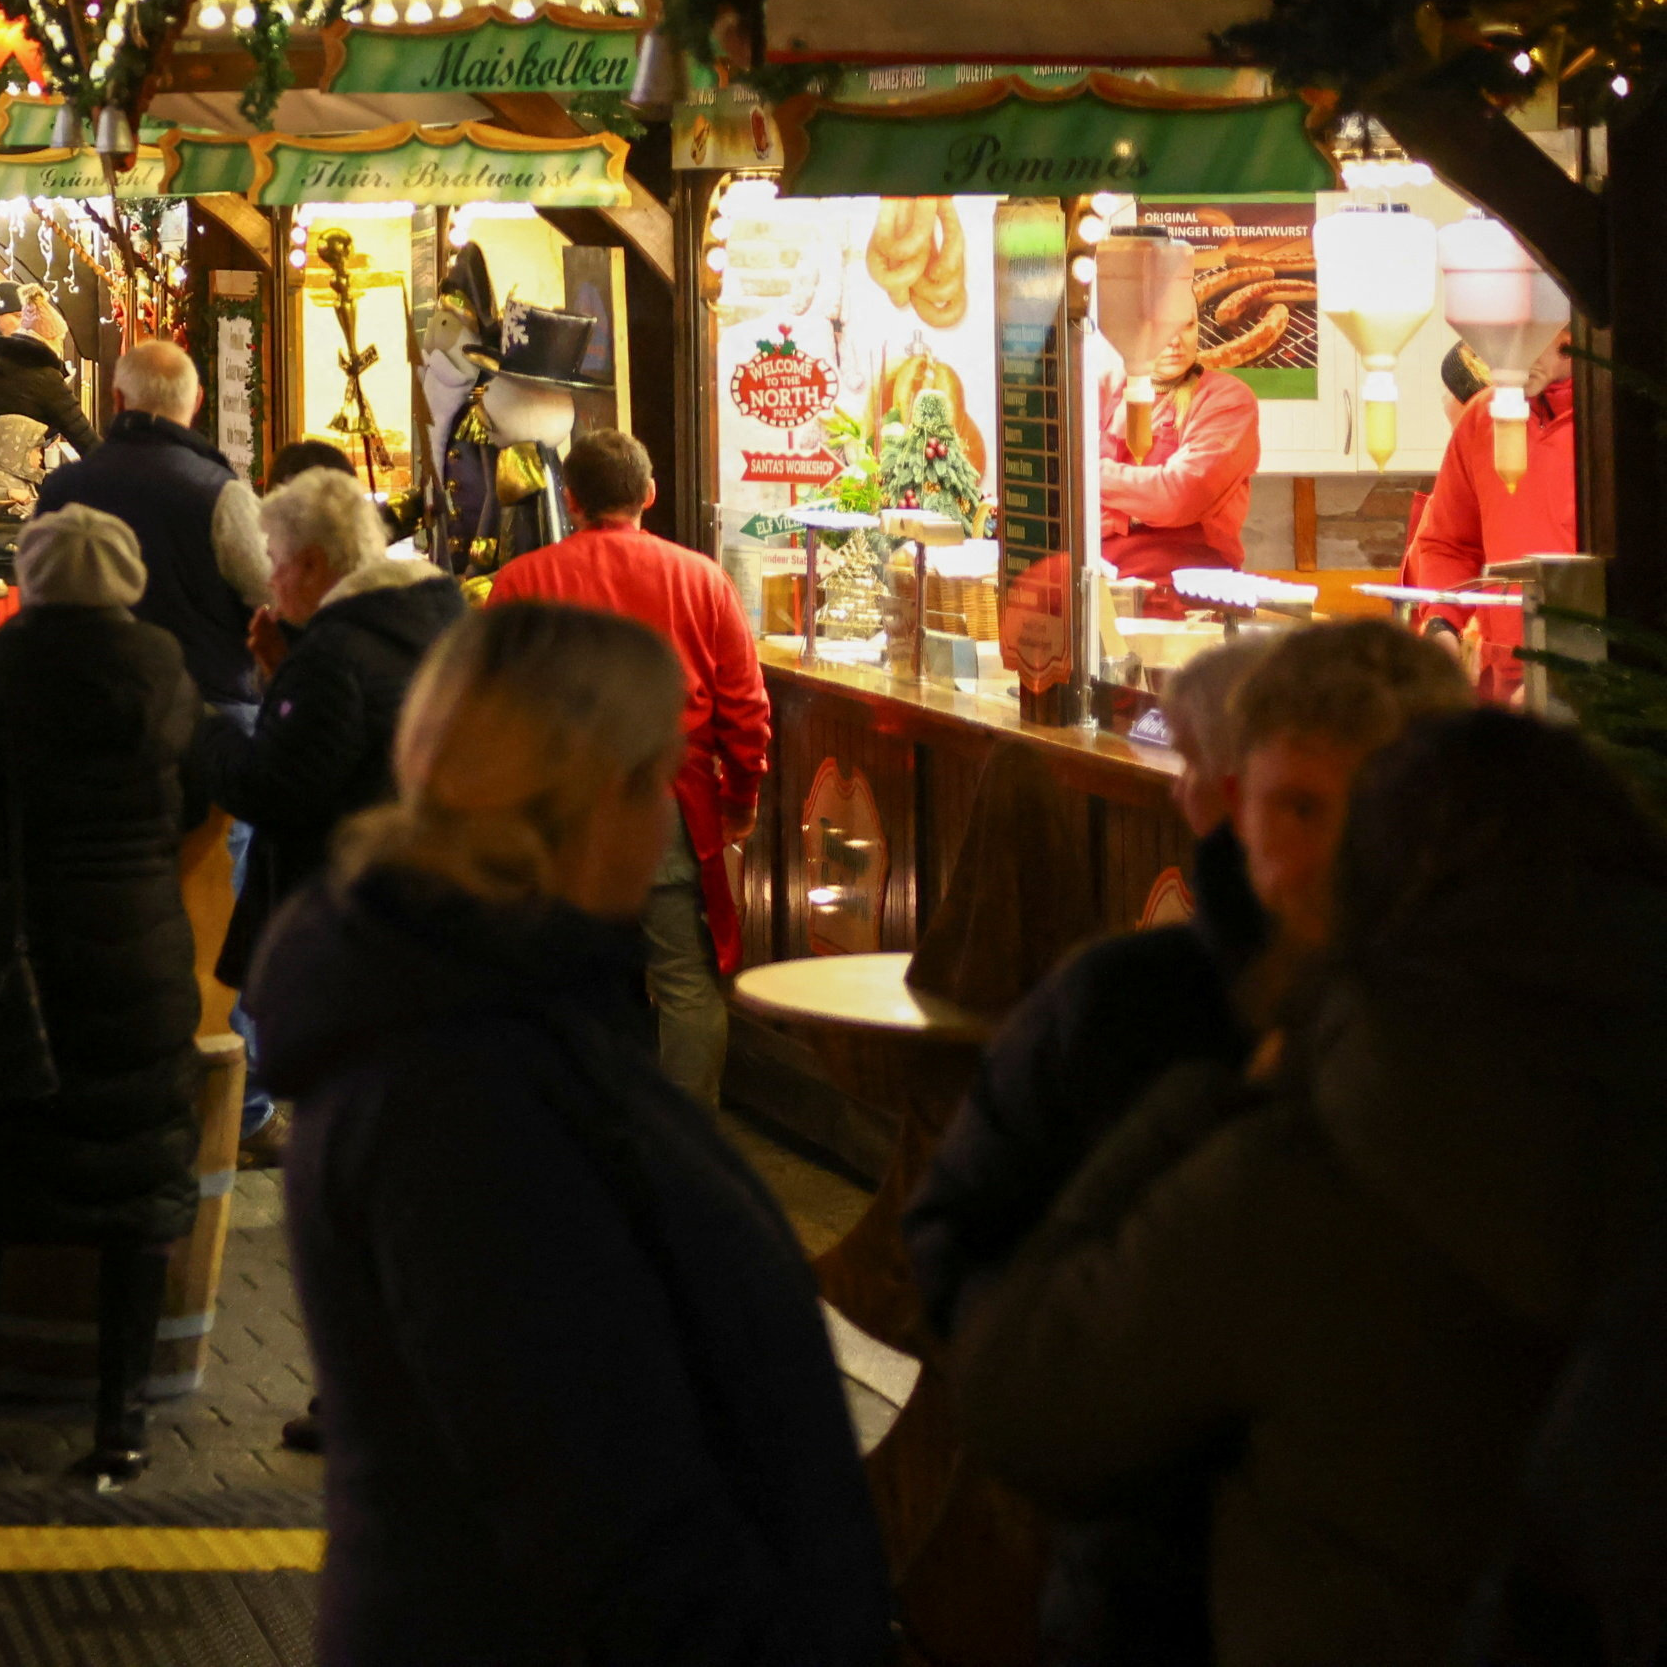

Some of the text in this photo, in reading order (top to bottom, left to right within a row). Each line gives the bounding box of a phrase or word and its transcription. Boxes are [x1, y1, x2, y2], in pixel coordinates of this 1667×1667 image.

[421, 40, 629, 87] Maiskolben
[944, 134, 1149, 182] Pommes
[40, 166, 154, 189] Grünohl
[403, 161, 580, 189] Bratwurst
[1144, 212, 1199, 223] ORIGINAL
[1167, 225, 1309, 237] RINGER ROSTBRATWURST
[750, 358, 813, 383] WELCOME
[766, 375, 801, 387] TO THE
[749, 385, 821, 408] NORTH
[773, 408, 798, 418] POLE
[785, 460, 835, 476] WORKSHOP
[755, 519, 774, 536] ELF
